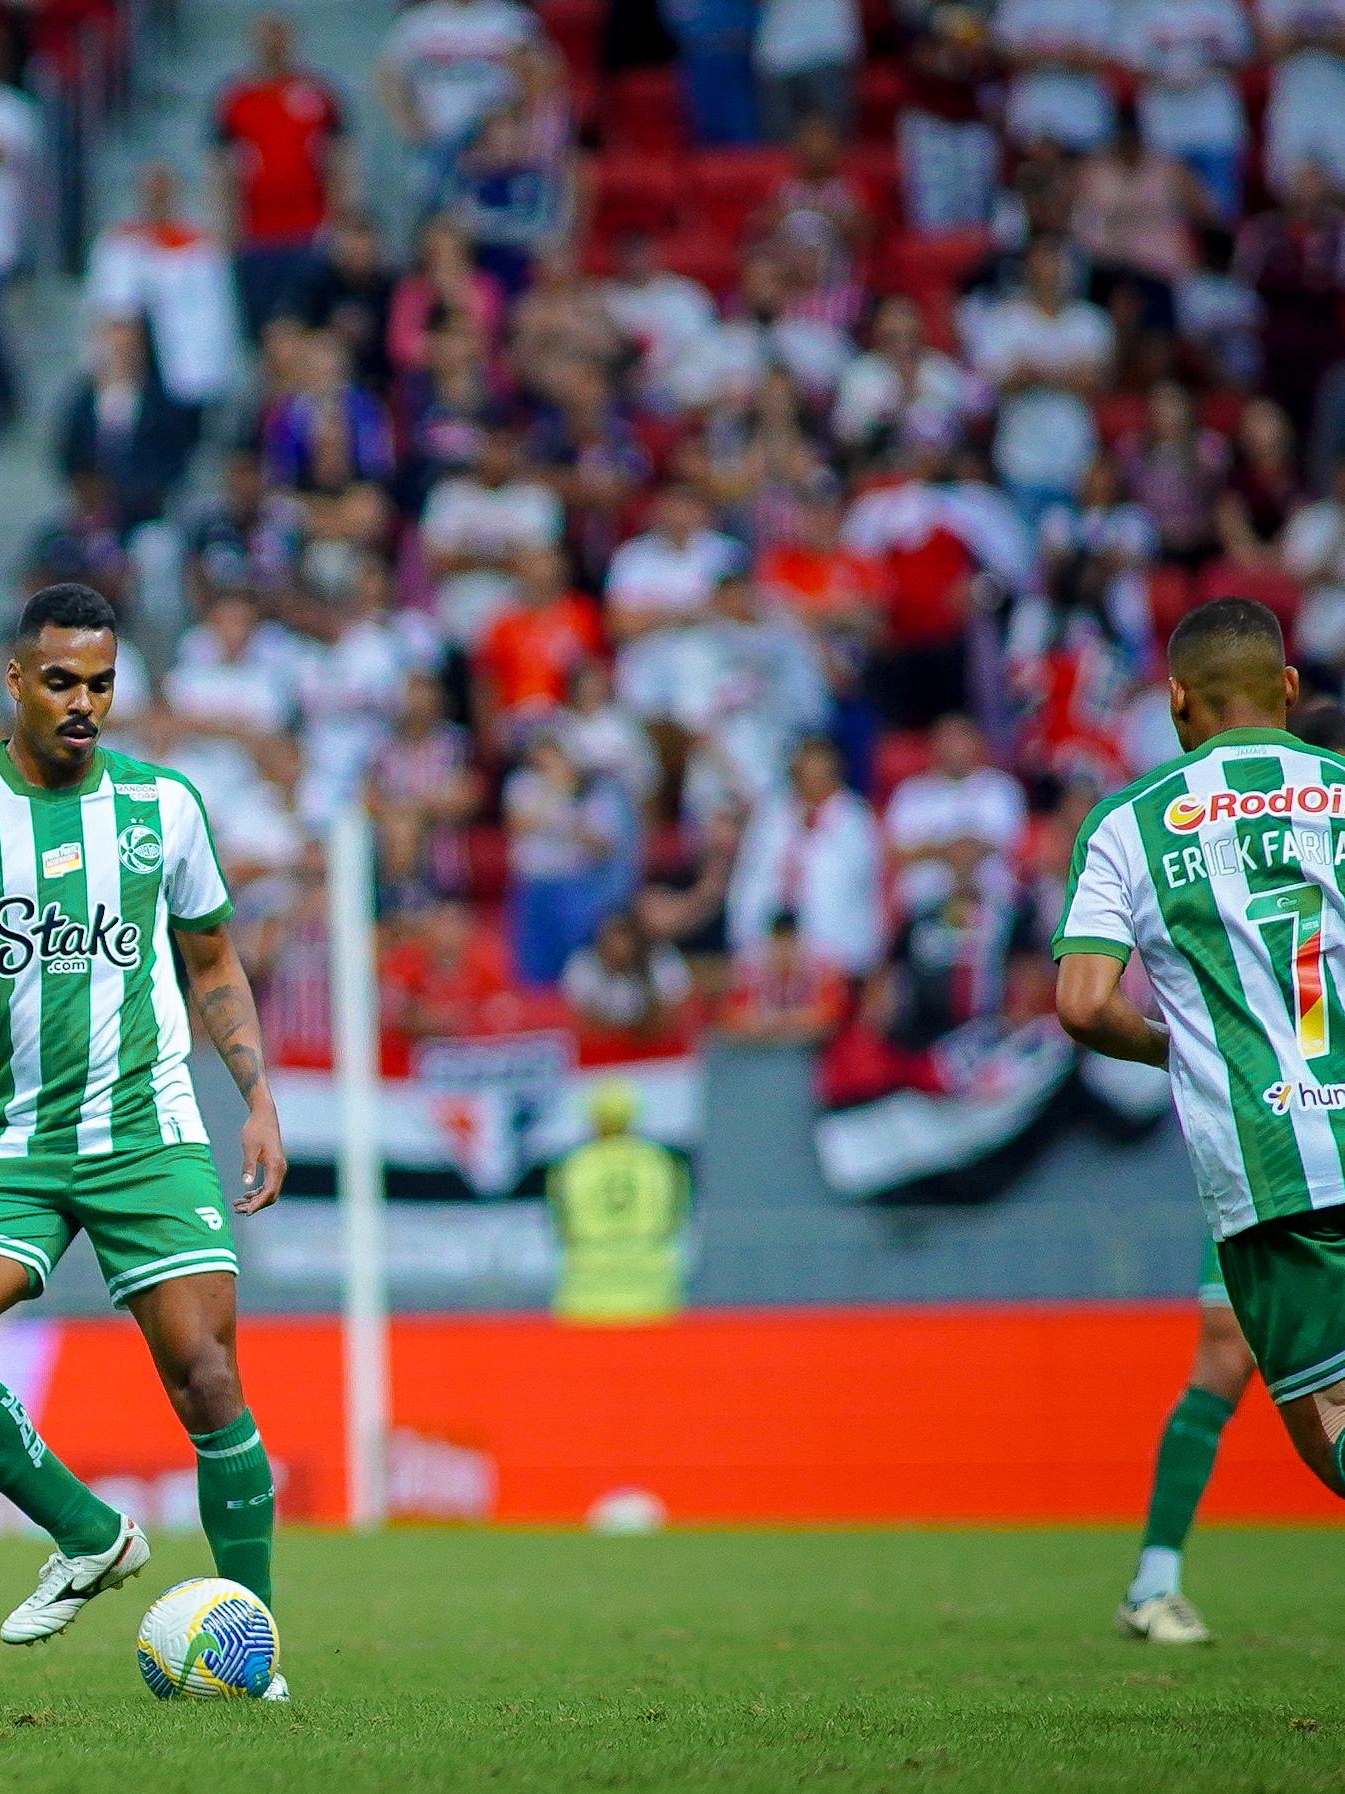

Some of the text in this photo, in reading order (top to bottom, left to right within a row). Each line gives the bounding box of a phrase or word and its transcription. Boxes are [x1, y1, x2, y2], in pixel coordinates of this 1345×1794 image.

[1210, 787, 1345, 822] RodOi
[1162, 835, 1257, 888] ERICK
[48, 960, 86, 973] .com
[1245, 882, 1331, 1060] 7
